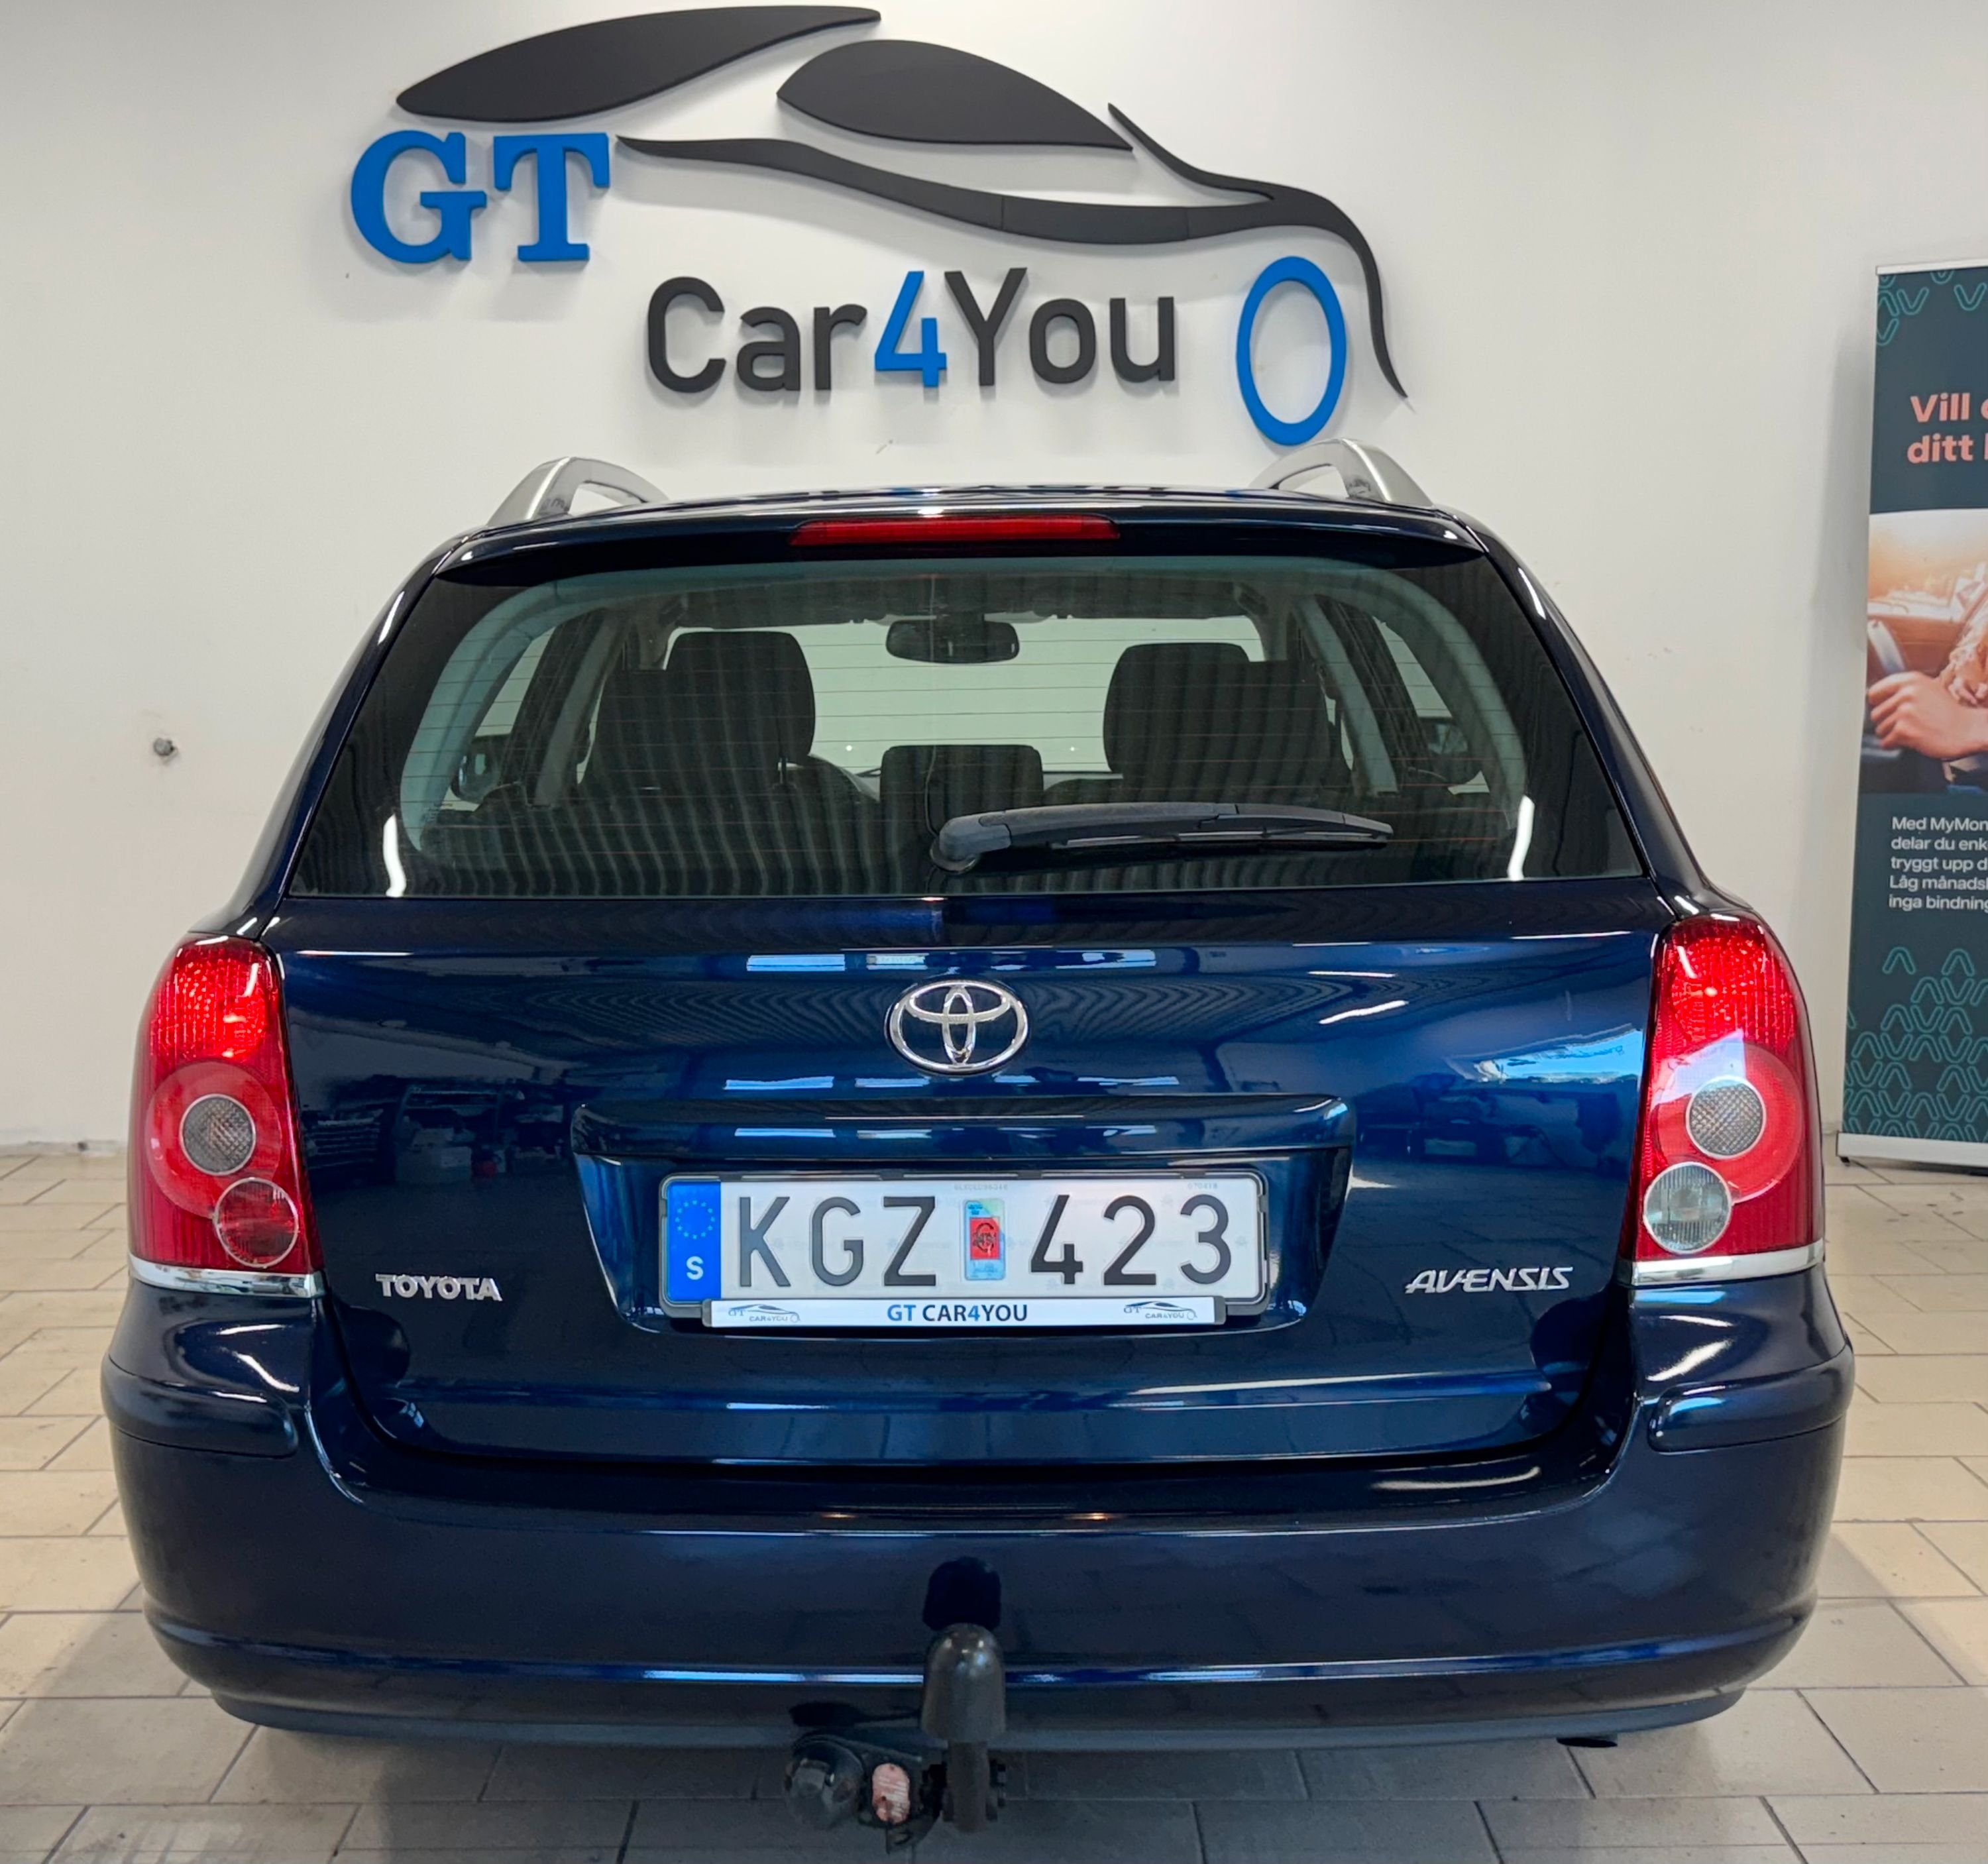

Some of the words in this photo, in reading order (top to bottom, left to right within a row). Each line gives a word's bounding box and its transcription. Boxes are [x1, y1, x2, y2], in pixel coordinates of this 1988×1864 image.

[351, 130, 610, 264] GT
[647, 268, 1176, 393] Car4You
[1910, 392, 1970, 423] Vill
[1907, 433, 1974, 464] ditt
[1892, 816, 1927, 830] Med
[1891, 836, 1931, 850] delar
[1934, 837, 1955, 850] du
[1959, 838, 1988, 851] enk
[1891, 857, 1939, 873] tryggt
[1942, 859, 1973, 873] upp
[1889, 875, 1918, 892] Låg
[1889, 894, 1922, 911] inga
[739, 1195, 937, 1287] KGZ
[1030, 1194, 1231, 1286] 423
[686, 1255, 704, 1280] S
[1405, 1266, 1574, 1294] AVENSIS
[375, 1274, 503, 1301] TOYOTA
[887, 1304, 916, 1321] GT
[922, 1304, 1028, 1321] CAR4YOU
